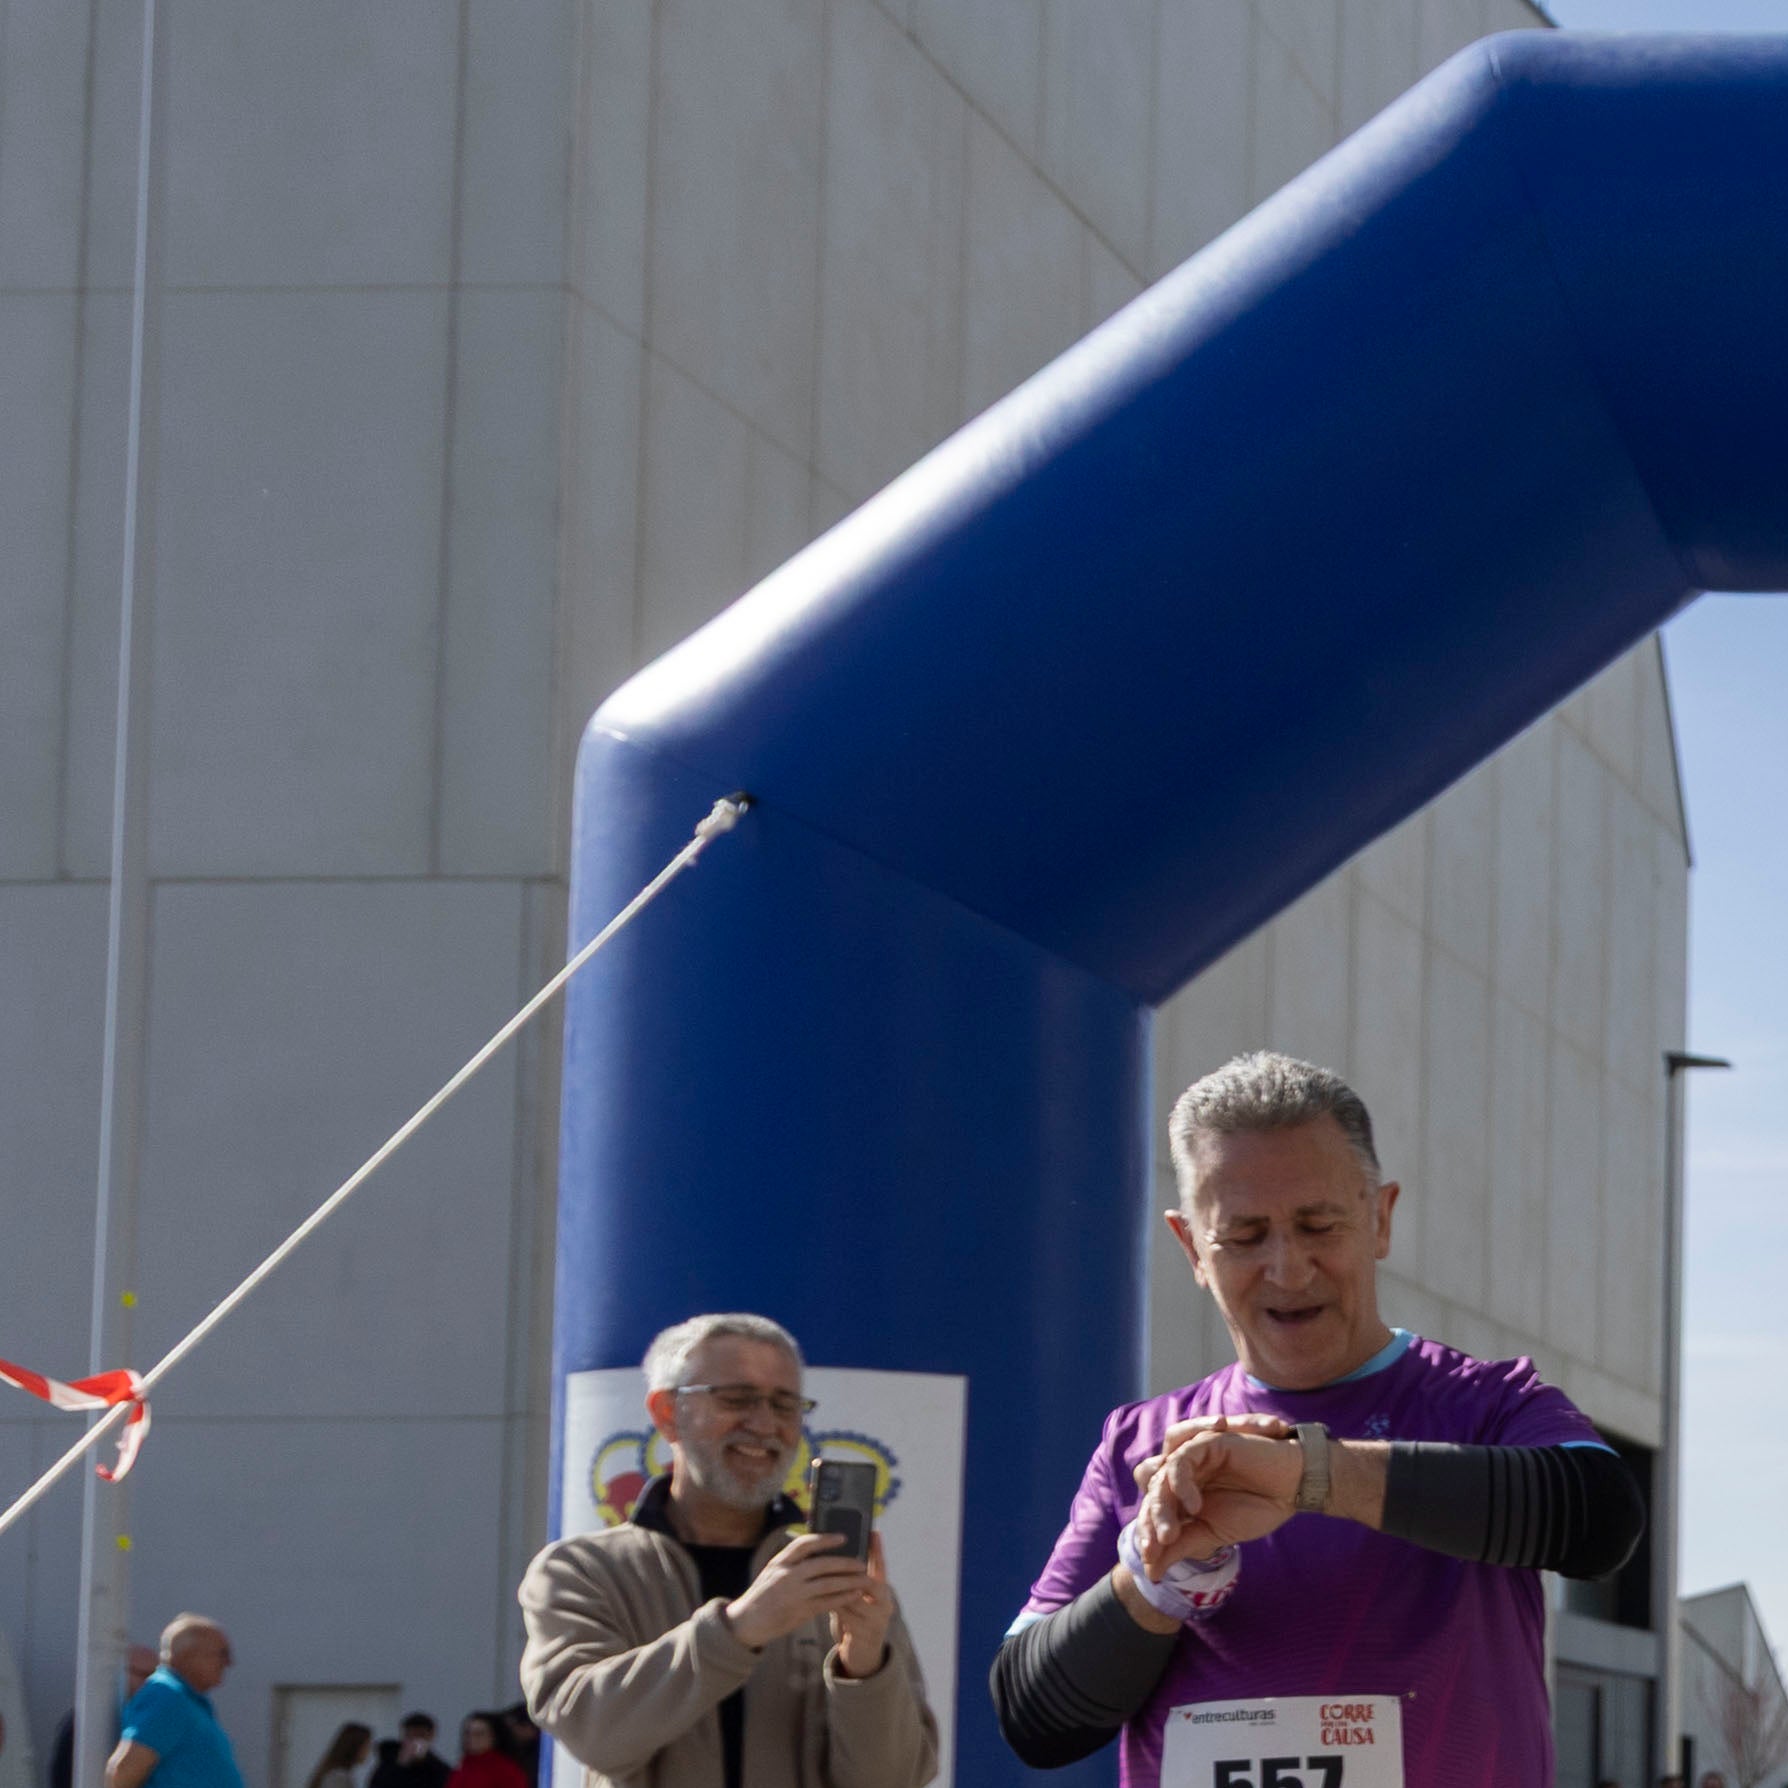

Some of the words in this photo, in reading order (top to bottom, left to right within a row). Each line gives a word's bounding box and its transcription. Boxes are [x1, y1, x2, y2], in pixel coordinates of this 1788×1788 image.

[1192, 1708, 1275, 1725] entreculturas
[1320, 1704, 1376, 1723] CORRE
[1320, 1727, 1376, 1746] CAUSA
